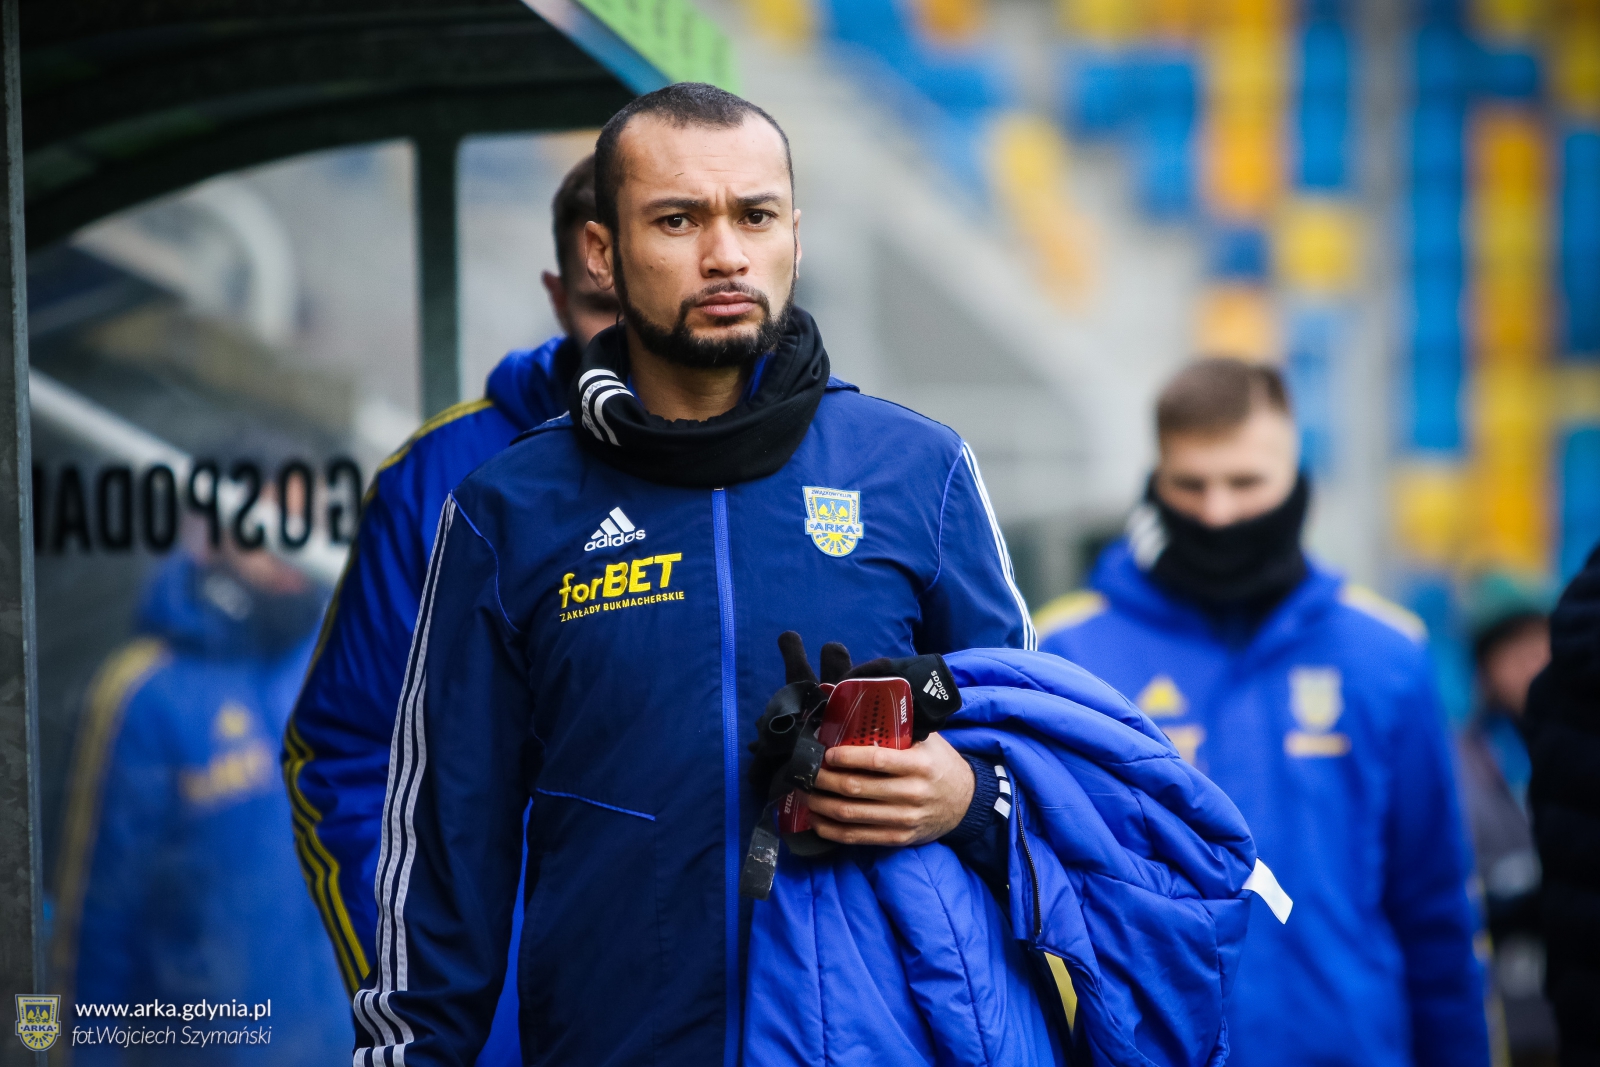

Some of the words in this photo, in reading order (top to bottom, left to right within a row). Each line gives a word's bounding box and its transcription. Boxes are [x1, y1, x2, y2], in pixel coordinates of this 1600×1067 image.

[584, 529, 646, 552] adidas
[814, 522, 856, 535] ARKA
[559, 552, 682, 609] forBET
[559, 604, 601, 623] ZAKŁADY
[603, 591, 685, 611] BUKMACHERSKIE
[931, 670, 949, 701] adidas
